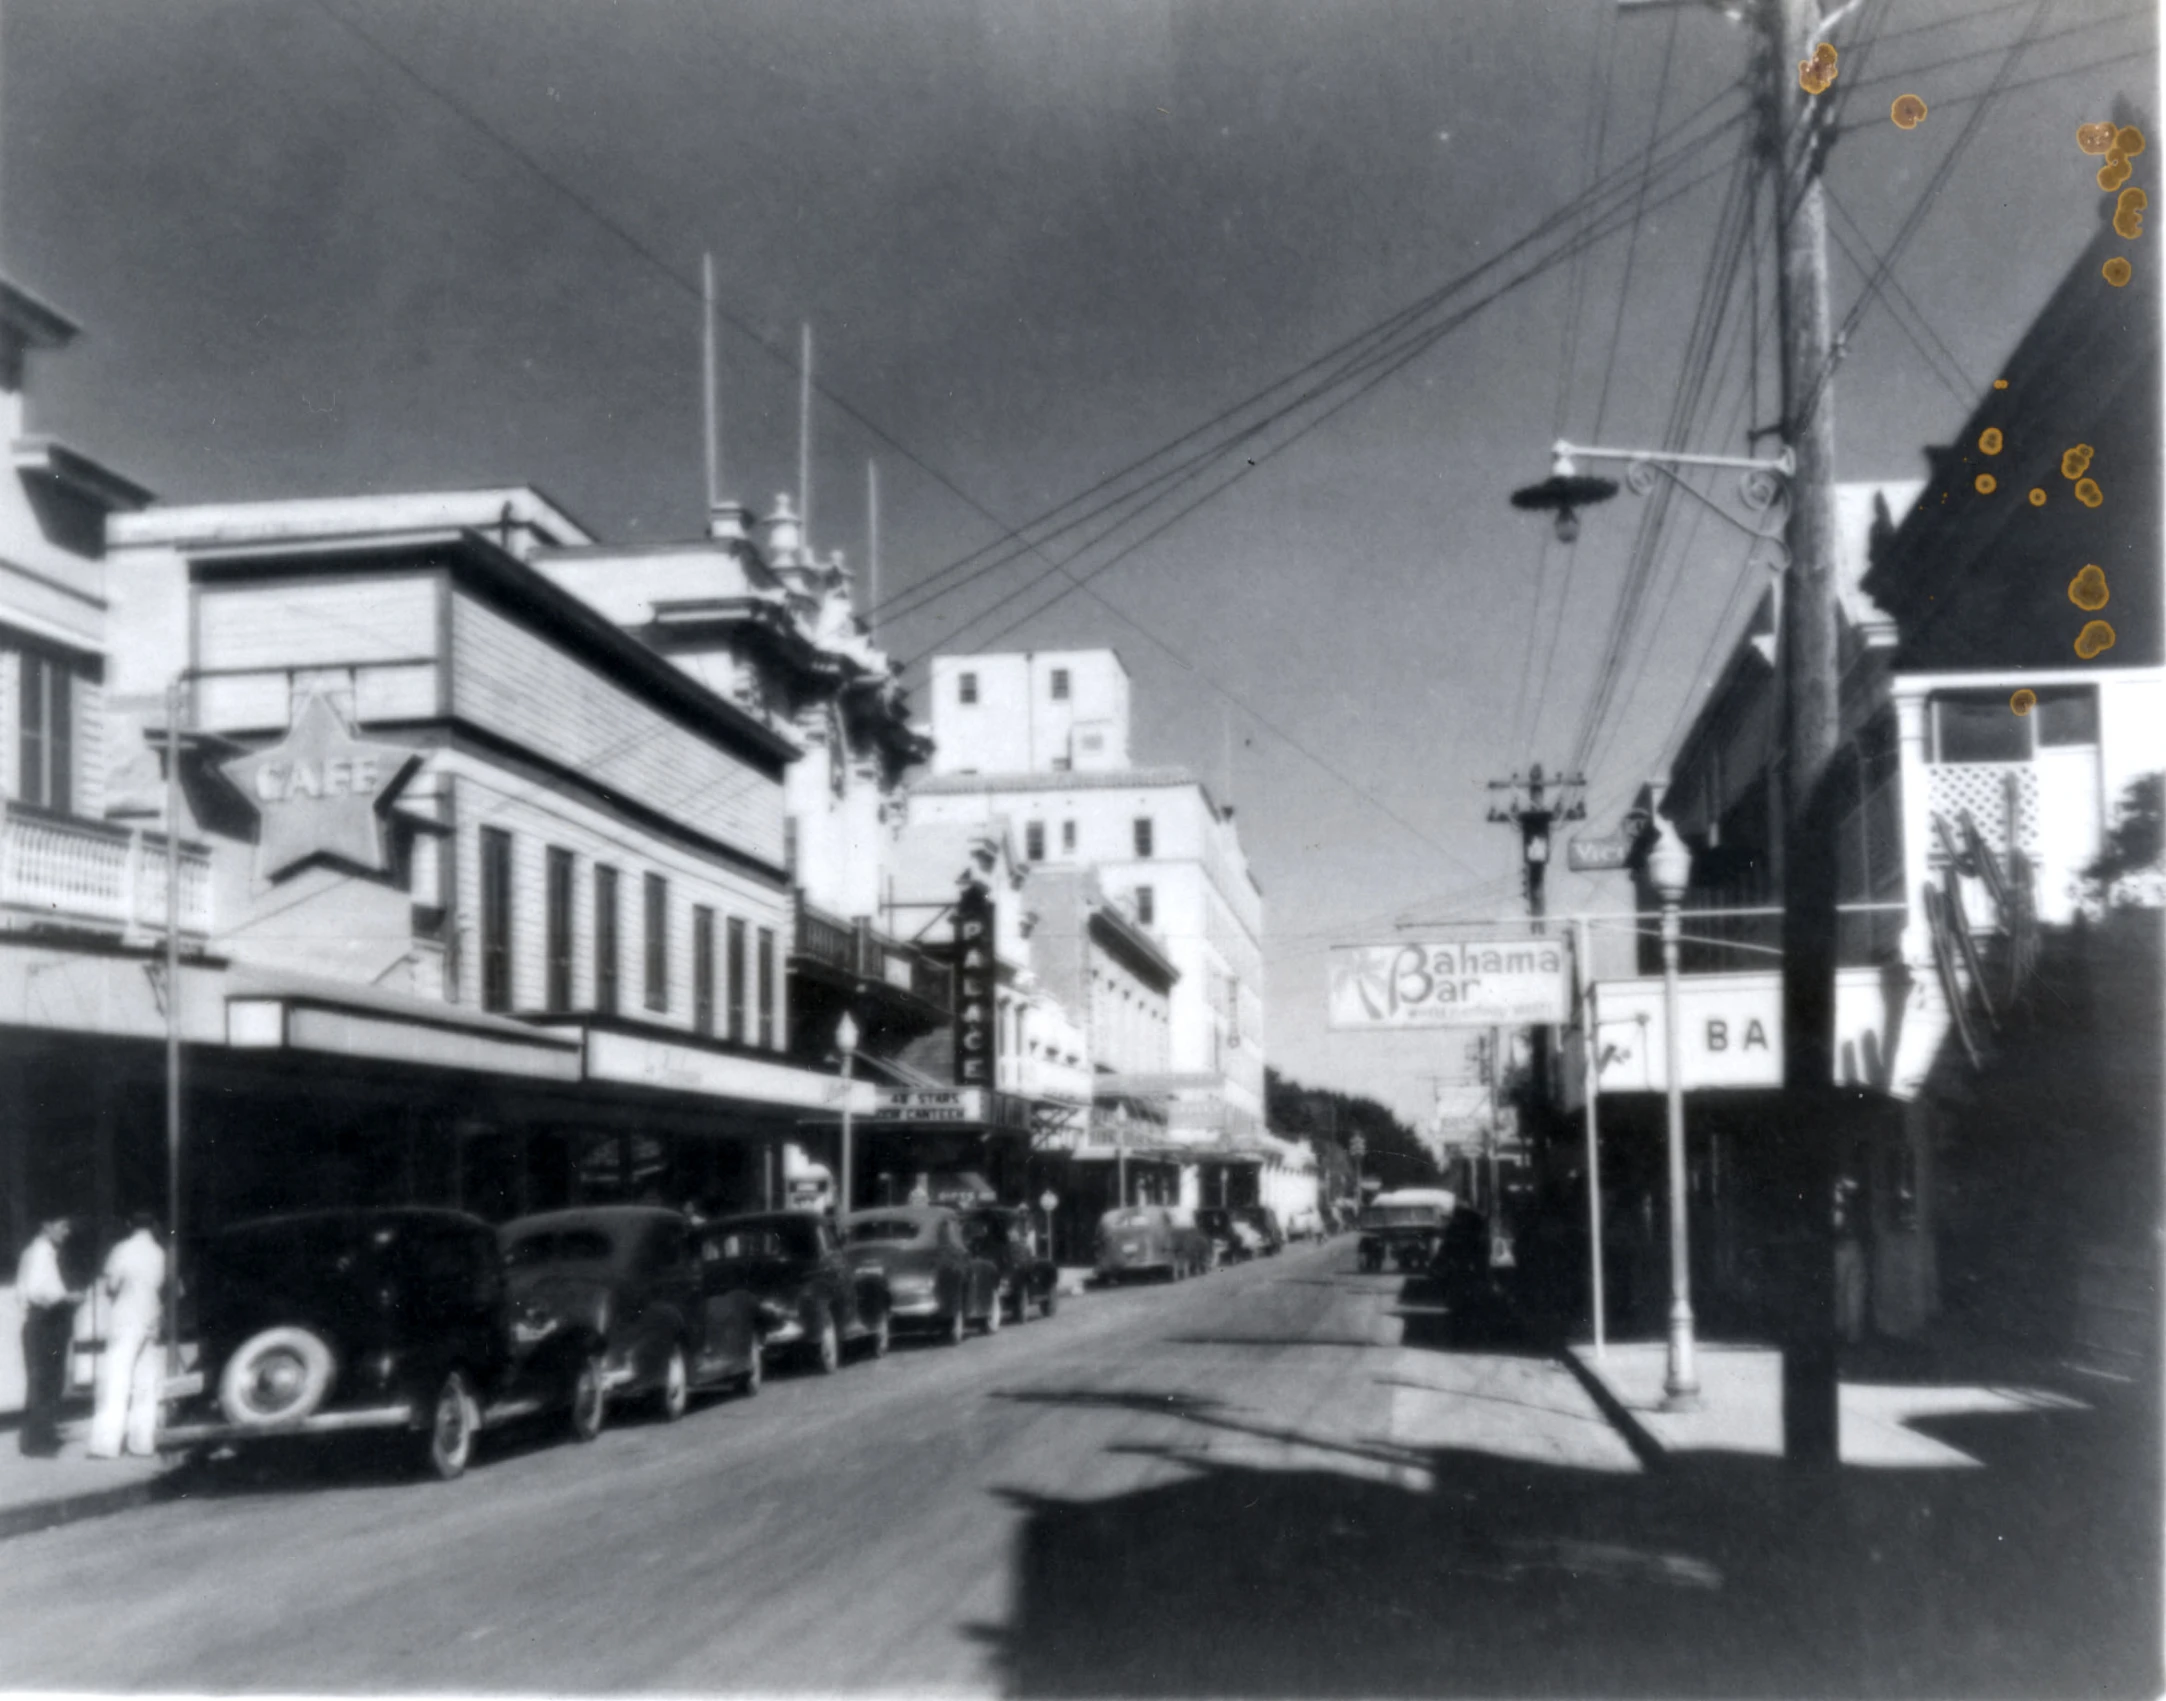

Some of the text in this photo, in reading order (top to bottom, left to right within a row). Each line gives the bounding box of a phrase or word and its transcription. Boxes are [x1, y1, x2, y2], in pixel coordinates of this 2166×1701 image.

[255, 758, 379, 801] CAFE
[962, 919, 984, 1079] PALACE
[1389, 943, 1560, 1017] Bahama
[918, 1091, 960, 1104] STARS
